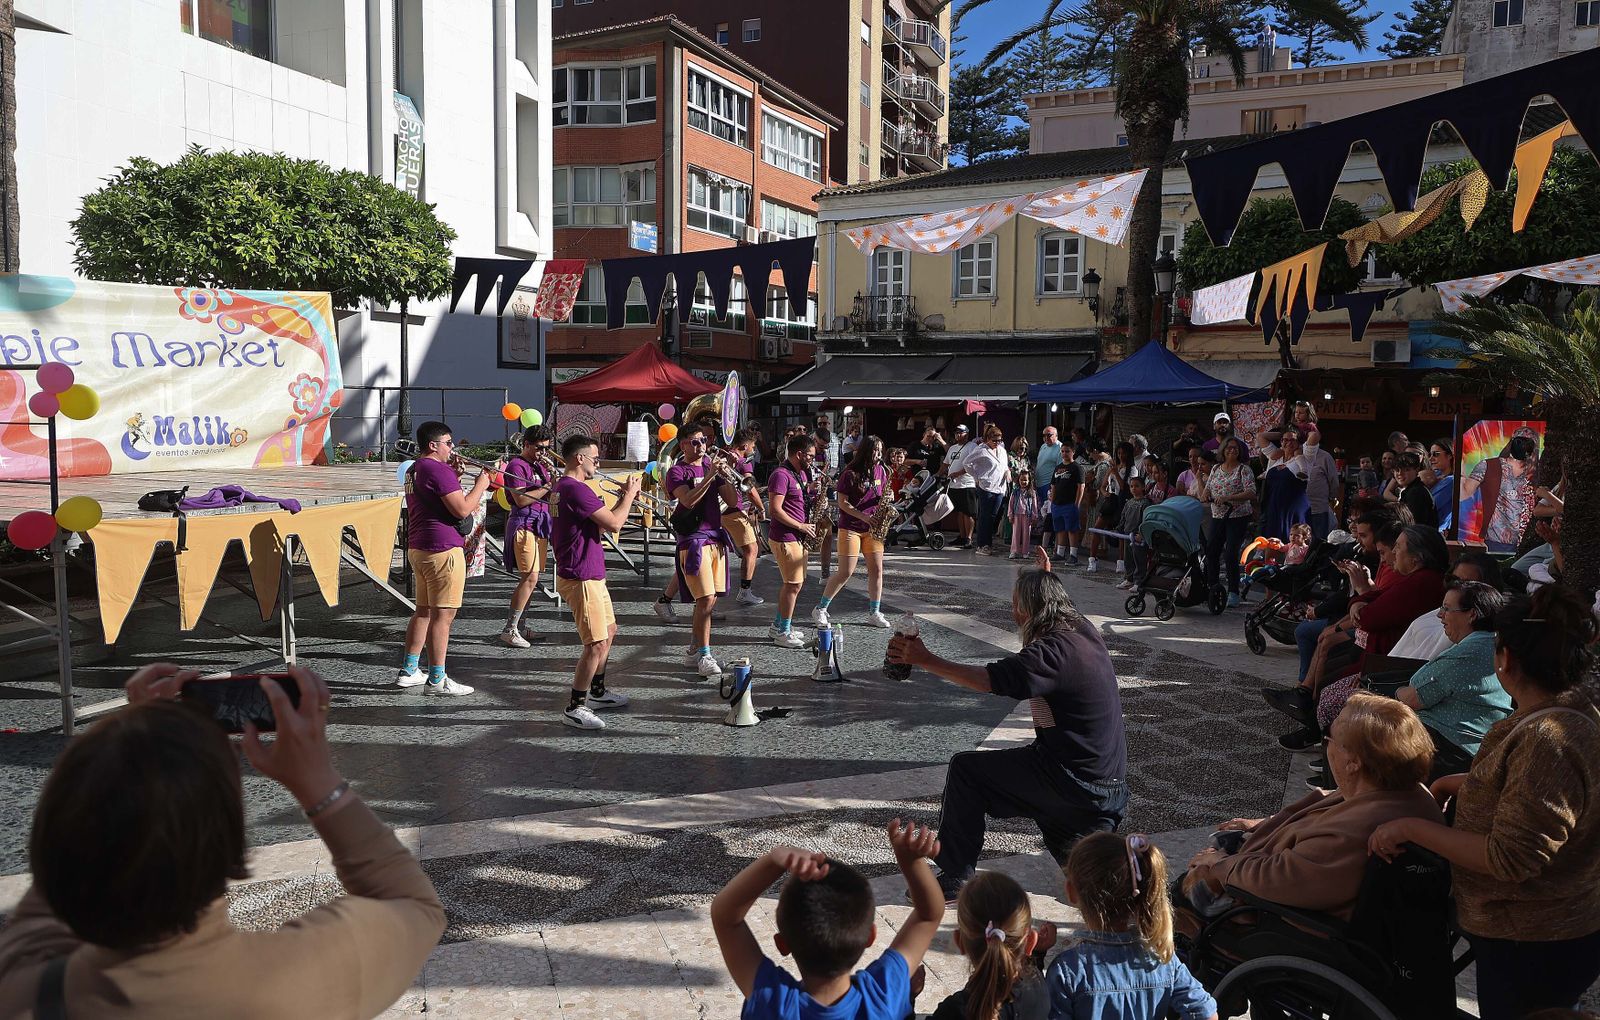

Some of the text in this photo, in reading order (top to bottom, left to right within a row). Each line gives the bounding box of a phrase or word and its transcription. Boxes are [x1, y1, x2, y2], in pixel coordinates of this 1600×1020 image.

[398, 118, 409, 176] NACHO
[111, 331, 286, 368] Market
[1315, 401, 1370, 416] PATATAS
[1420, 401, 1471, 417] ASADAS
[152, 415, 231, 446] Malik
[155, 449, 189, 457] eventos
